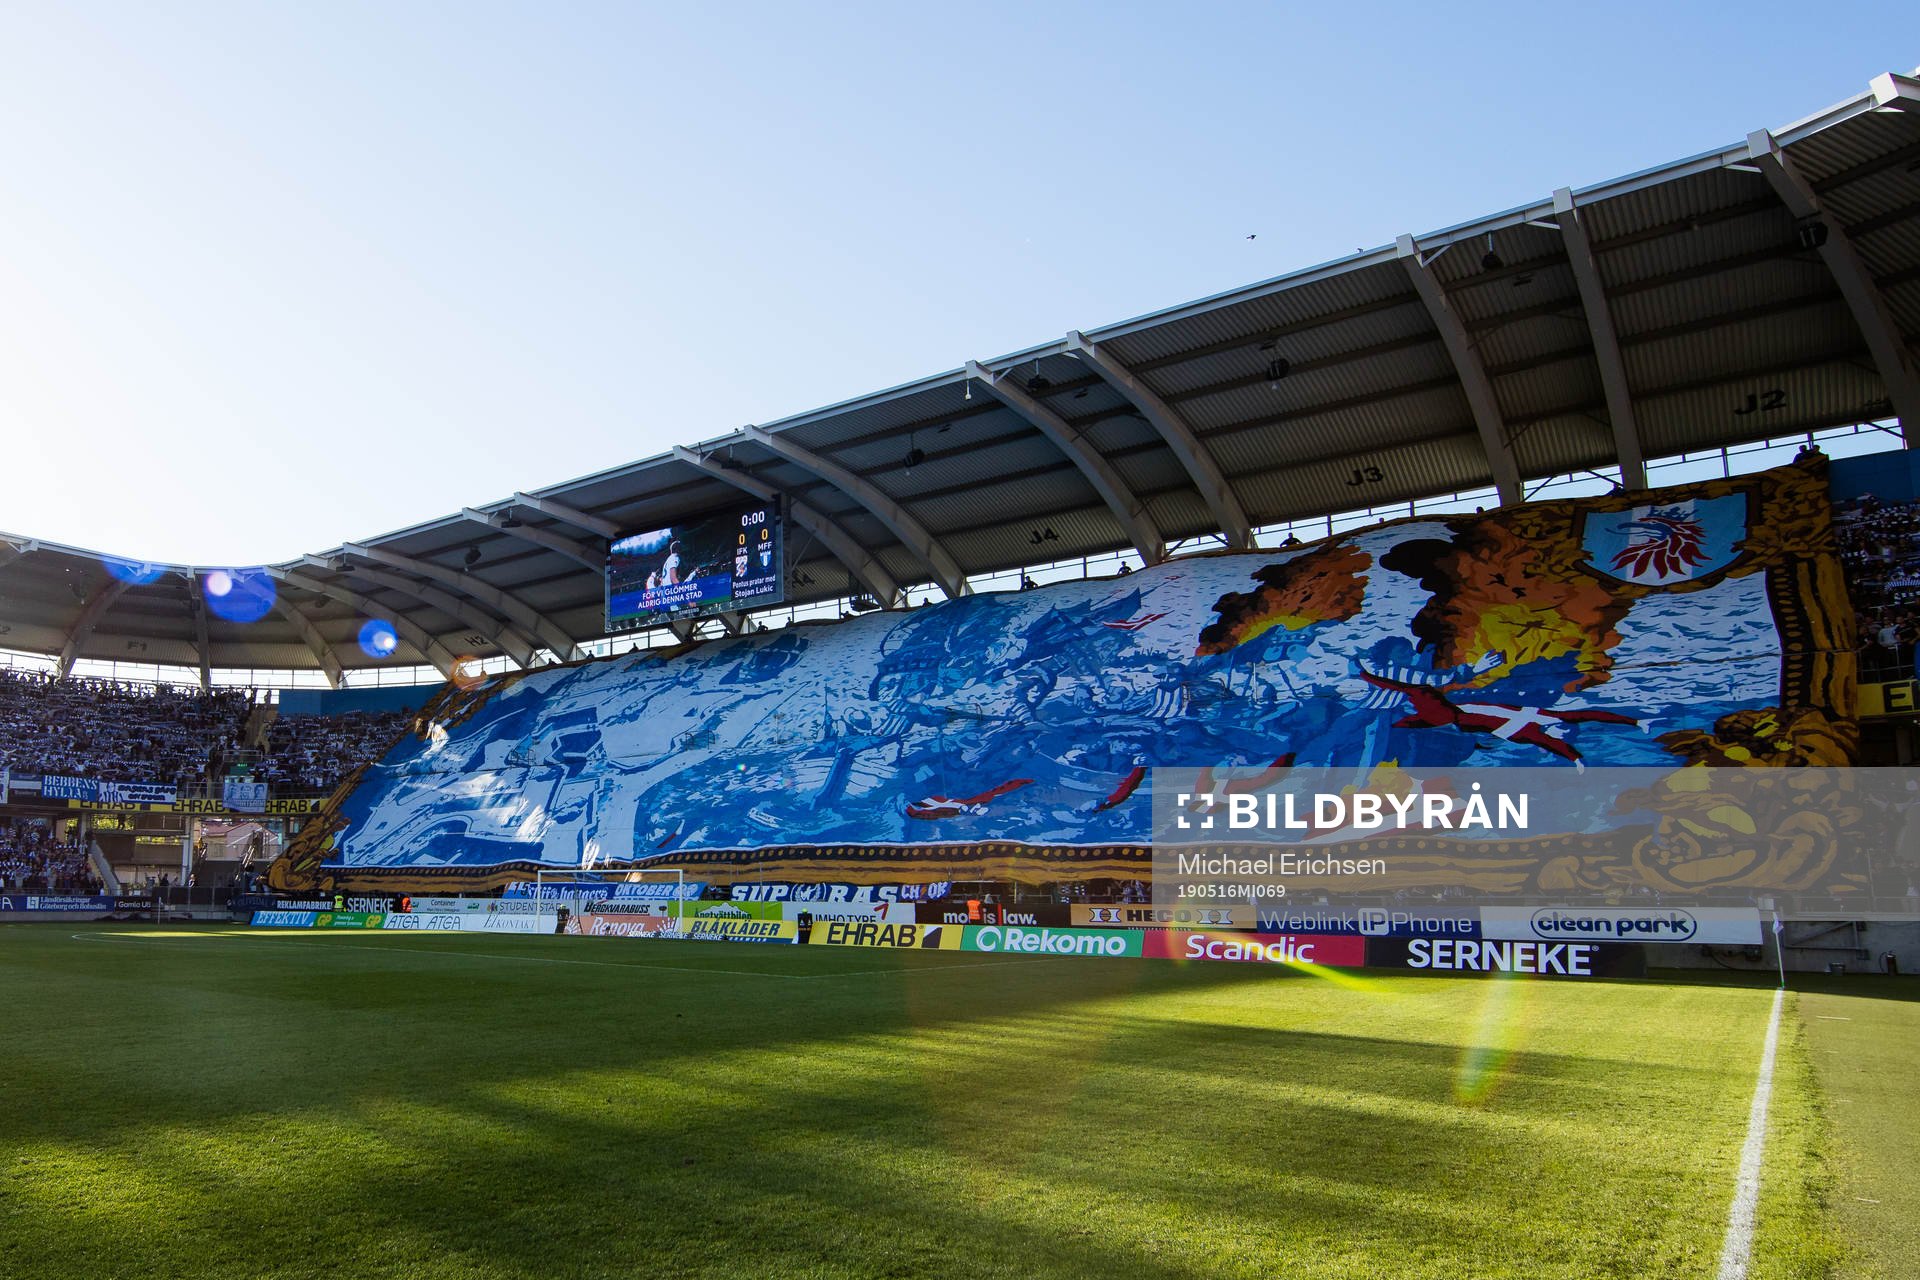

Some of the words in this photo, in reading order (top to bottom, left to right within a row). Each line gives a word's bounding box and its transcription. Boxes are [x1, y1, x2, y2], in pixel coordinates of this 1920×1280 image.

[1735, 390, 1786, 414] J2
[1348, 467, 1383, 485] J3
[741, 511, 765, 527] 0:00
[738, 533, 745, 545] 0
[761, 528, 768, 540] 0
[736, 546, 748, 556] IFK
[757, 541, 773, 551] MFF
[732, 580, 749, 589] Pontus
[749, 577, 764, 587] pratar
[765, 574, 776, 582] med
[638, 599, 661, 609] ALDRIG
[662, 594, 685, 605] DENNA
[685, 590, 703, 600] STAD
[642, 591, 655, 600] FÖR
[664, 583, 698, 596] GLÖMMER
[734, 588, 755, 598] Stojan
[44, 775, 98, 790] BEBBENS
[614, 884, 674, 897] OKTOBER
[347, 898, 393, 913] SERNEKE
[256, 911, 309, 925] EFFEKTIV
[317, 913, 332, 927] GP
[366, 914, 382, 928] GP
[982, 908, 996, 924] is
[1002, 908, 1038, 925] law.
[1126, 909, 1192, 923] HECO
[1261, 911, 1355, 931] Weblink
[1392, 912, 1472, 933] Phone
[1537, 911, 1612, 932] clean
[1617, 912, 1689, 936] park
[590, 916, 645, 936] Renova
[691, 918, 780, 937] BLÅKLÄDER
[693, 932, 724, 941] SERNEKE
[826, 922, 917, 948] EHRAB
[1004, 928, 1126, 955] Rekomo
[1185, 935, 1315, 964] Scandic
[1407, 938, 1592, 975] SERNEKE
